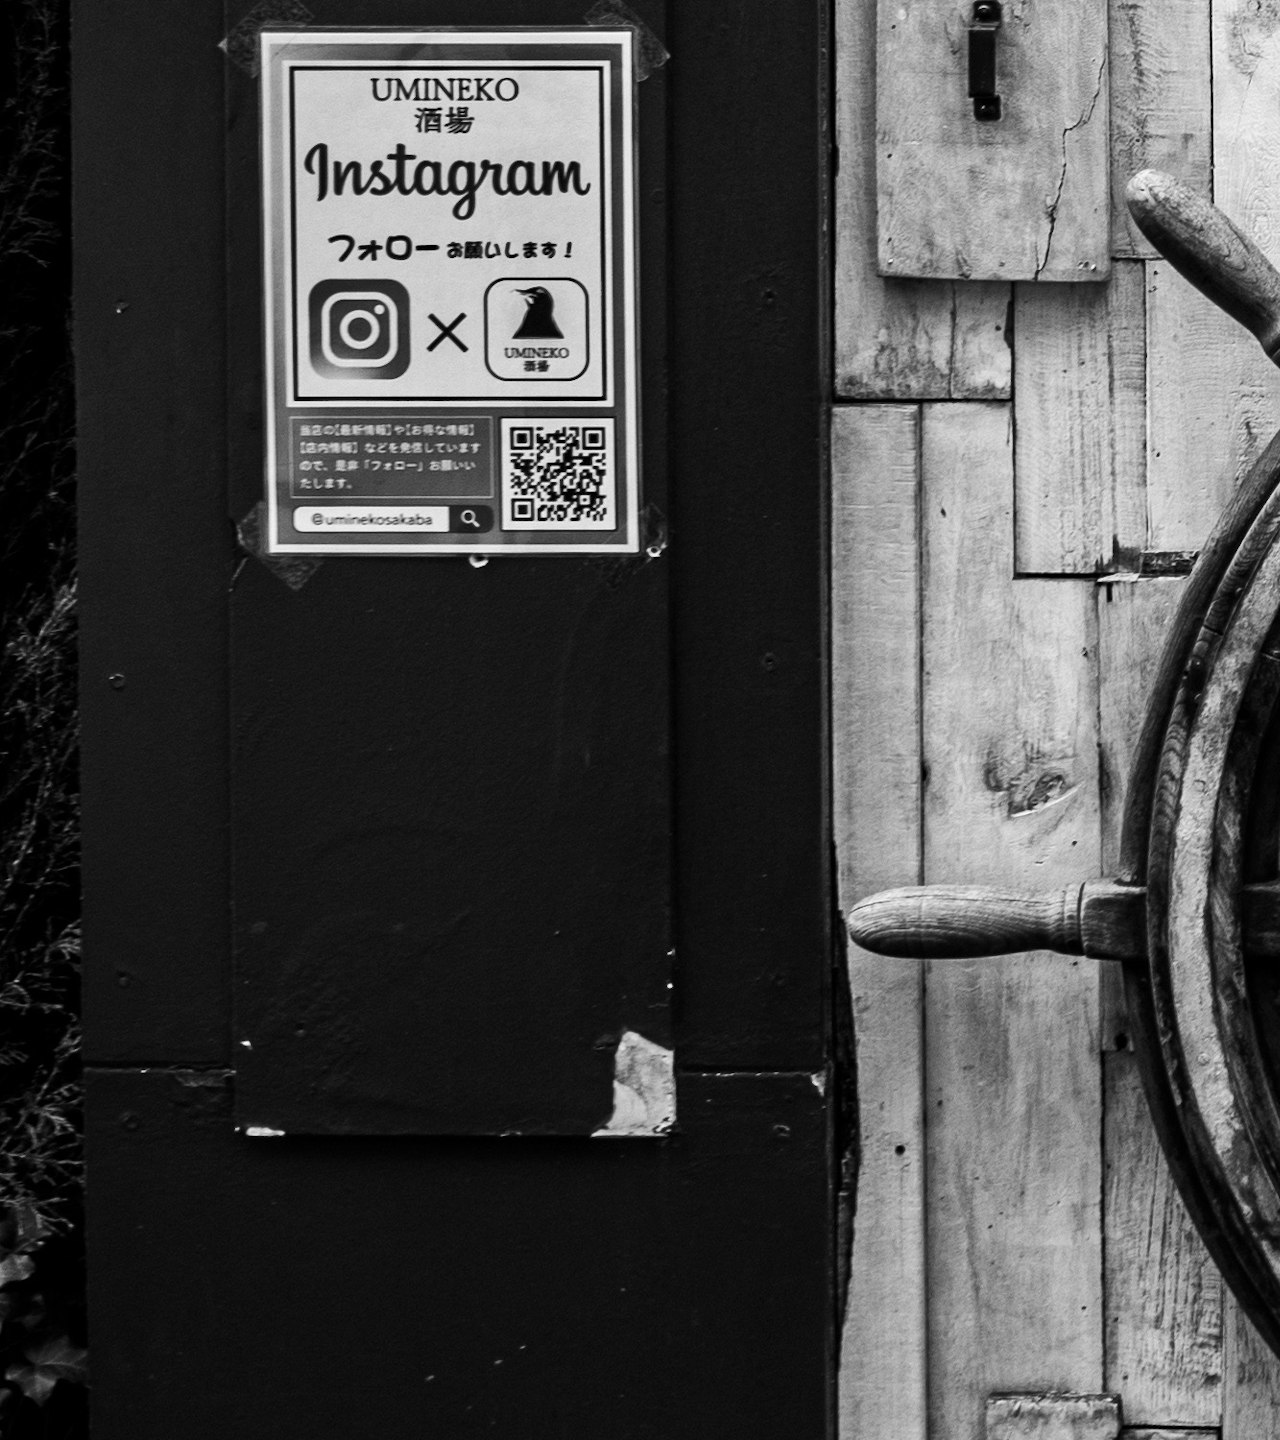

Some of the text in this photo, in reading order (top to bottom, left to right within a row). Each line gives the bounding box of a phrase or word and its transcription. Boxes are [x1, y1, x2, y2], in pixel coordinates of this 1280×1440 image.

[370, 77, 519, 101] UMINEKO
[414, 106, 475, 134] 酒場
[304, 142, 591, 221] Instagram
[504, 347, 570, 359] UMINEKO
[312, 512, 434, 526] @uminekosakaba
